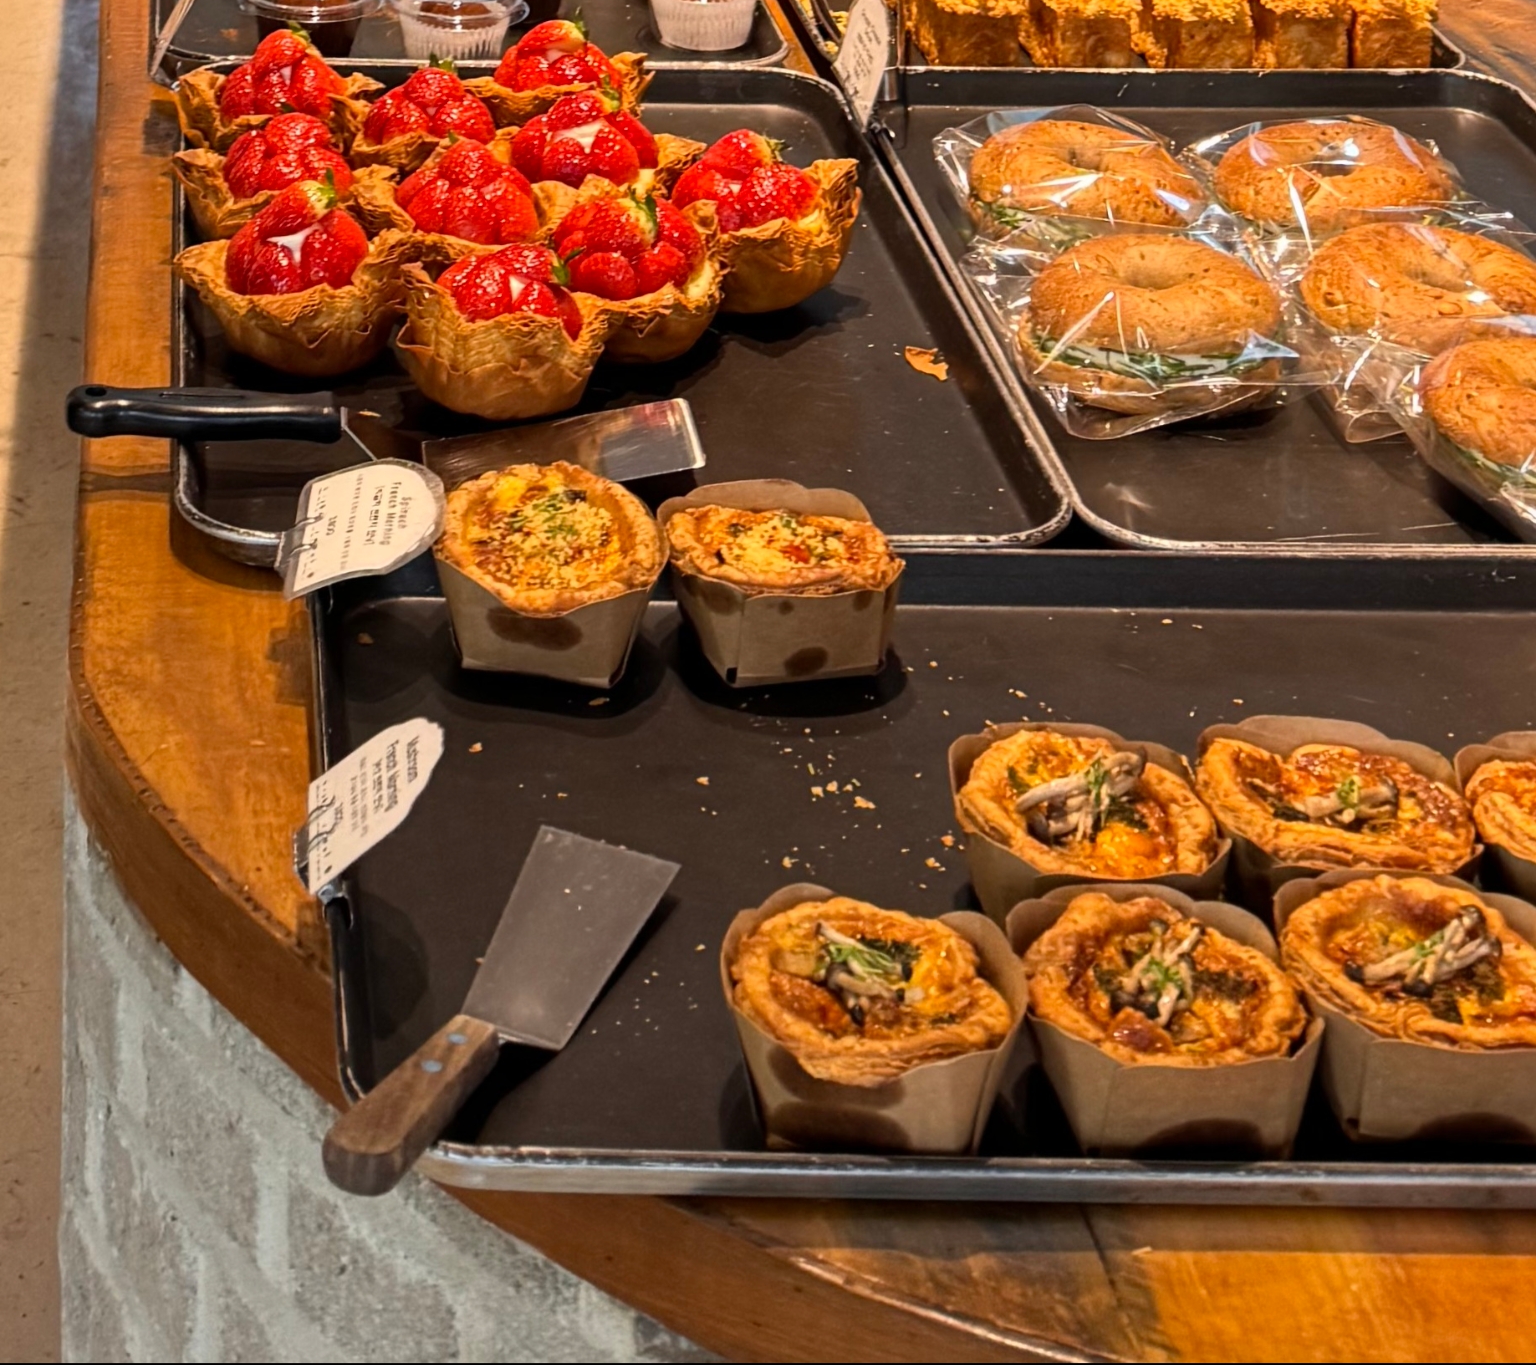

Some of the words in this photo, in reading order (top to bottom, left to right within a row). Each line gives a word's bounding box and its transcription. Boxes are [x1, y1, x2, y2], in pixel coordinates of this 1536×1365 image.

[387, 481, 402, 509] French
[378, 512, 397, 546] Morning
[397, 496, 412, 530] Spinach
